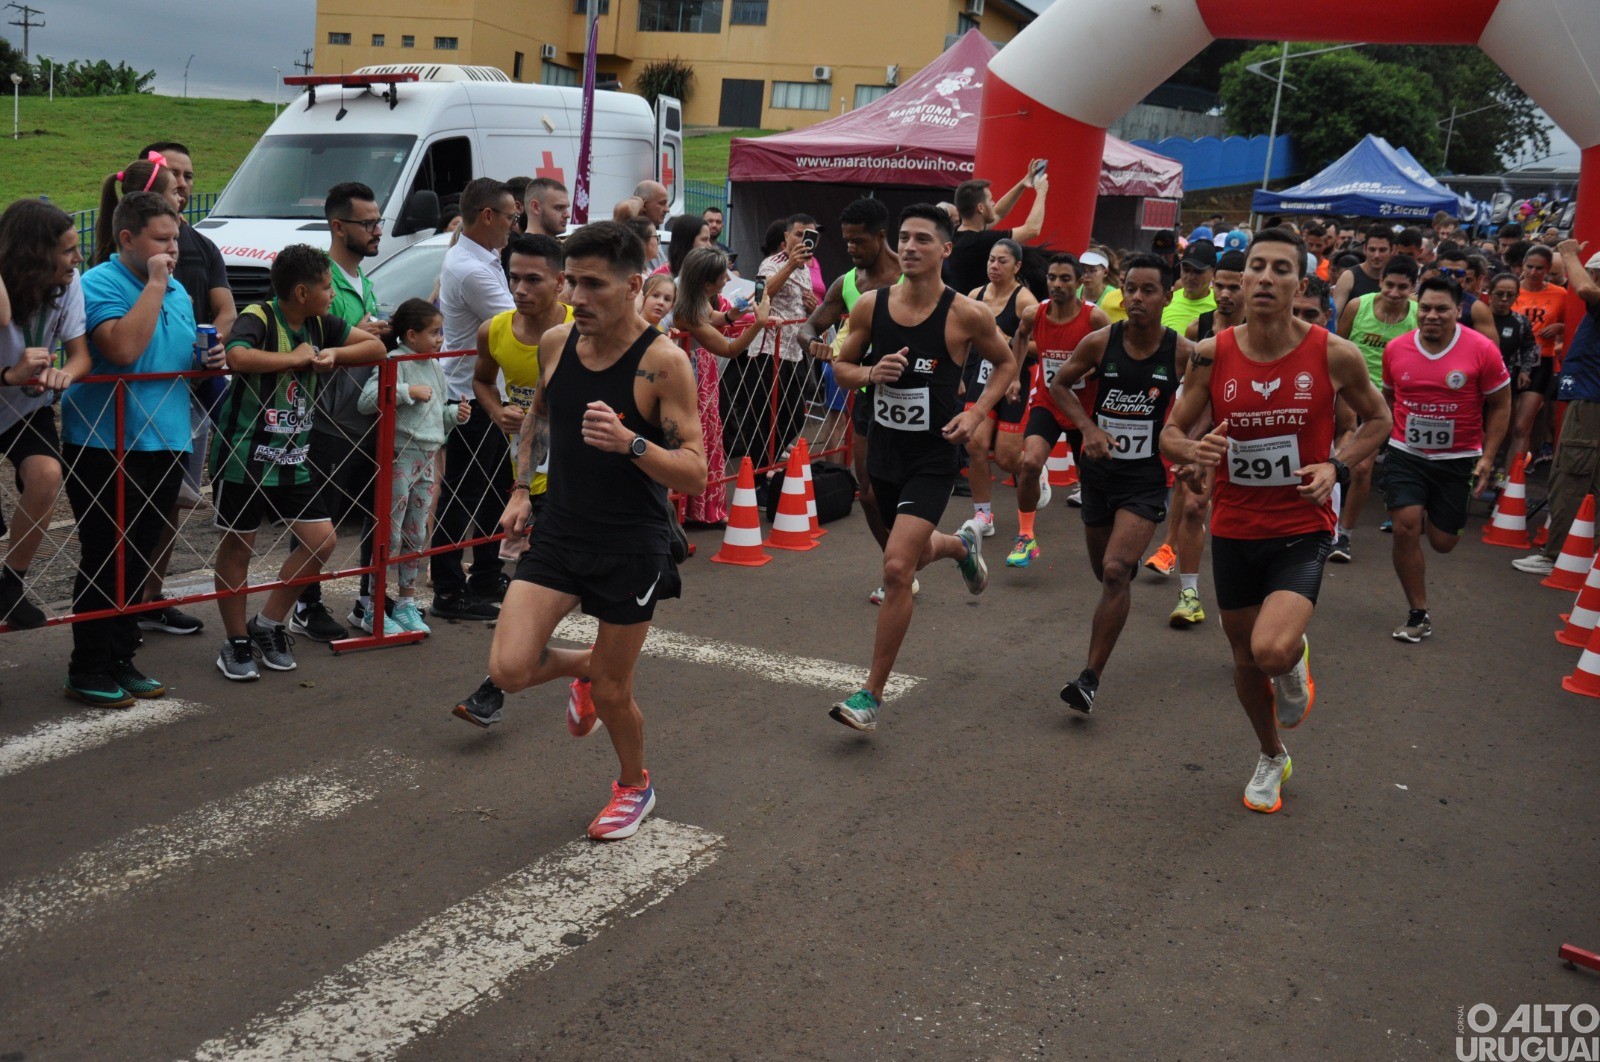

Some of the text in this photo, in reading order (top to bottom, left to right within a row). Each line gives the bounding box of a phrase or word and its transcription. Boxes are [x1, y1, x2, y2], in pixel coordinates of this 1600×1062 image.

[887, 104, 952, 119] MARATONA
[901, 115, 916, 124] DO
[919, 113, 960, 127] VINHO
[1393, 206, 1430, 216] Sicredi
[509, 384, 536, 396] PROJET
[876, 399, 925, 425] 262
[1101, 397, 1155, 415] Running
[1225, 414, 1306, 427] LORENAL
[1230, 410, 1271, 418] TREINAMENTO
[1408, 428, 1450, 445] 319
[1232, 455, 1291, 480] 291
